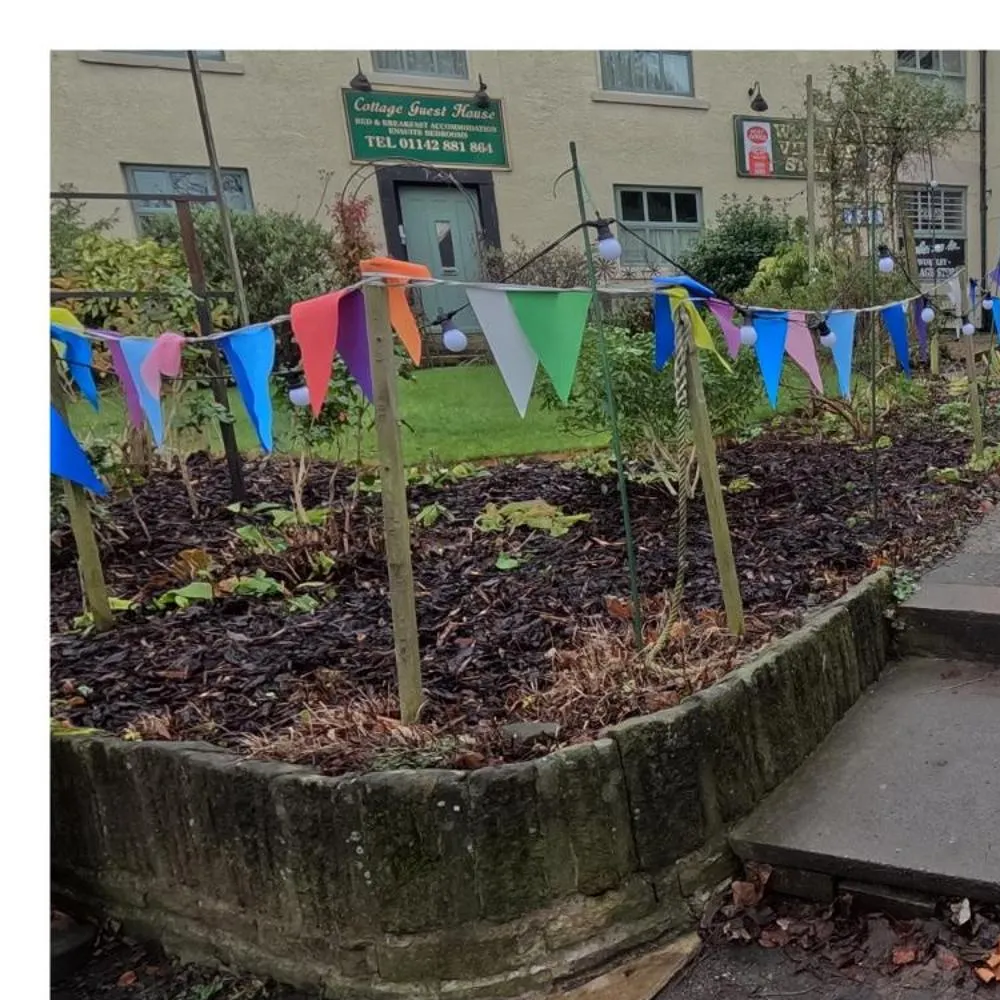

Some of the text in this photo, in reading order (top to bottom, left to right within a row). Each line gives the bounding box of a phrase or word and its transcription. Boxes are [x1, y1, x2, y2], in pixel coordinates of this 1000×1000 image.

[354, 97, 496, 120] Cottage Guest House
[365, 135, 493, 154] TEL 01142 881 864
